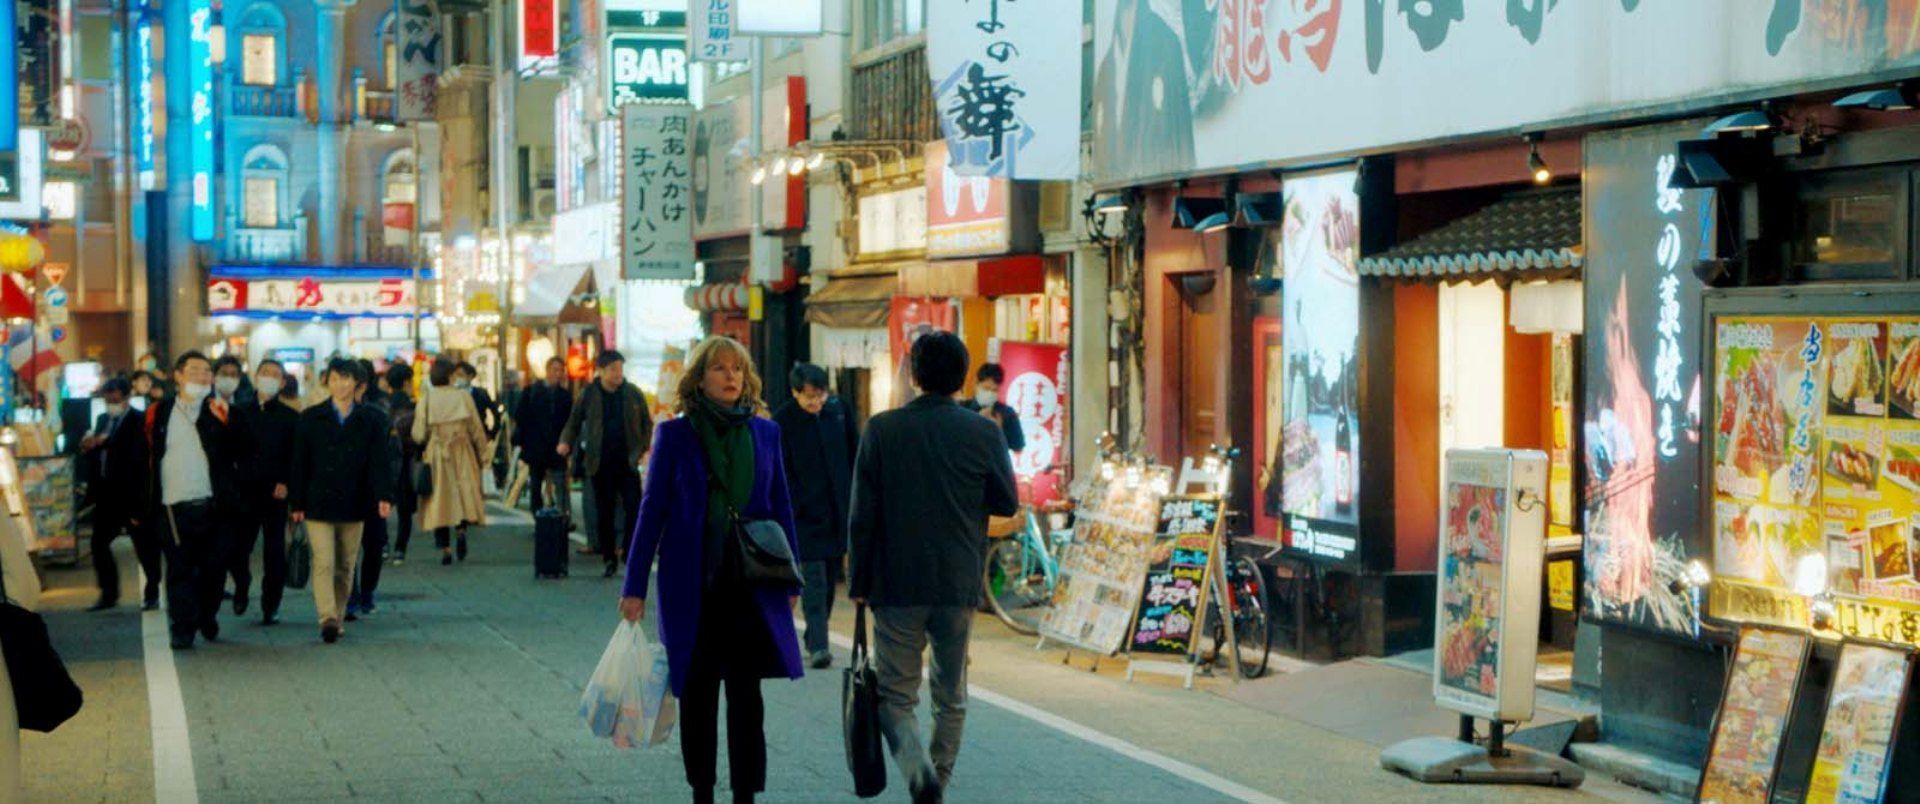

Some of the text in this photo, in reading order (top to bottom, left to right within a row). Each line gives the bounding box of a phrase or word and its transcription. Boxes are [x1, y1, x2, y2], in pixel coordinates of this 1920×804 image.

[614, 47, 687, 84] BAR
[704, 43, 734, 56] 2F
[630, 147, 656, 256] チャーハン
[659, 115, 688, 222] 肉あんかけ
